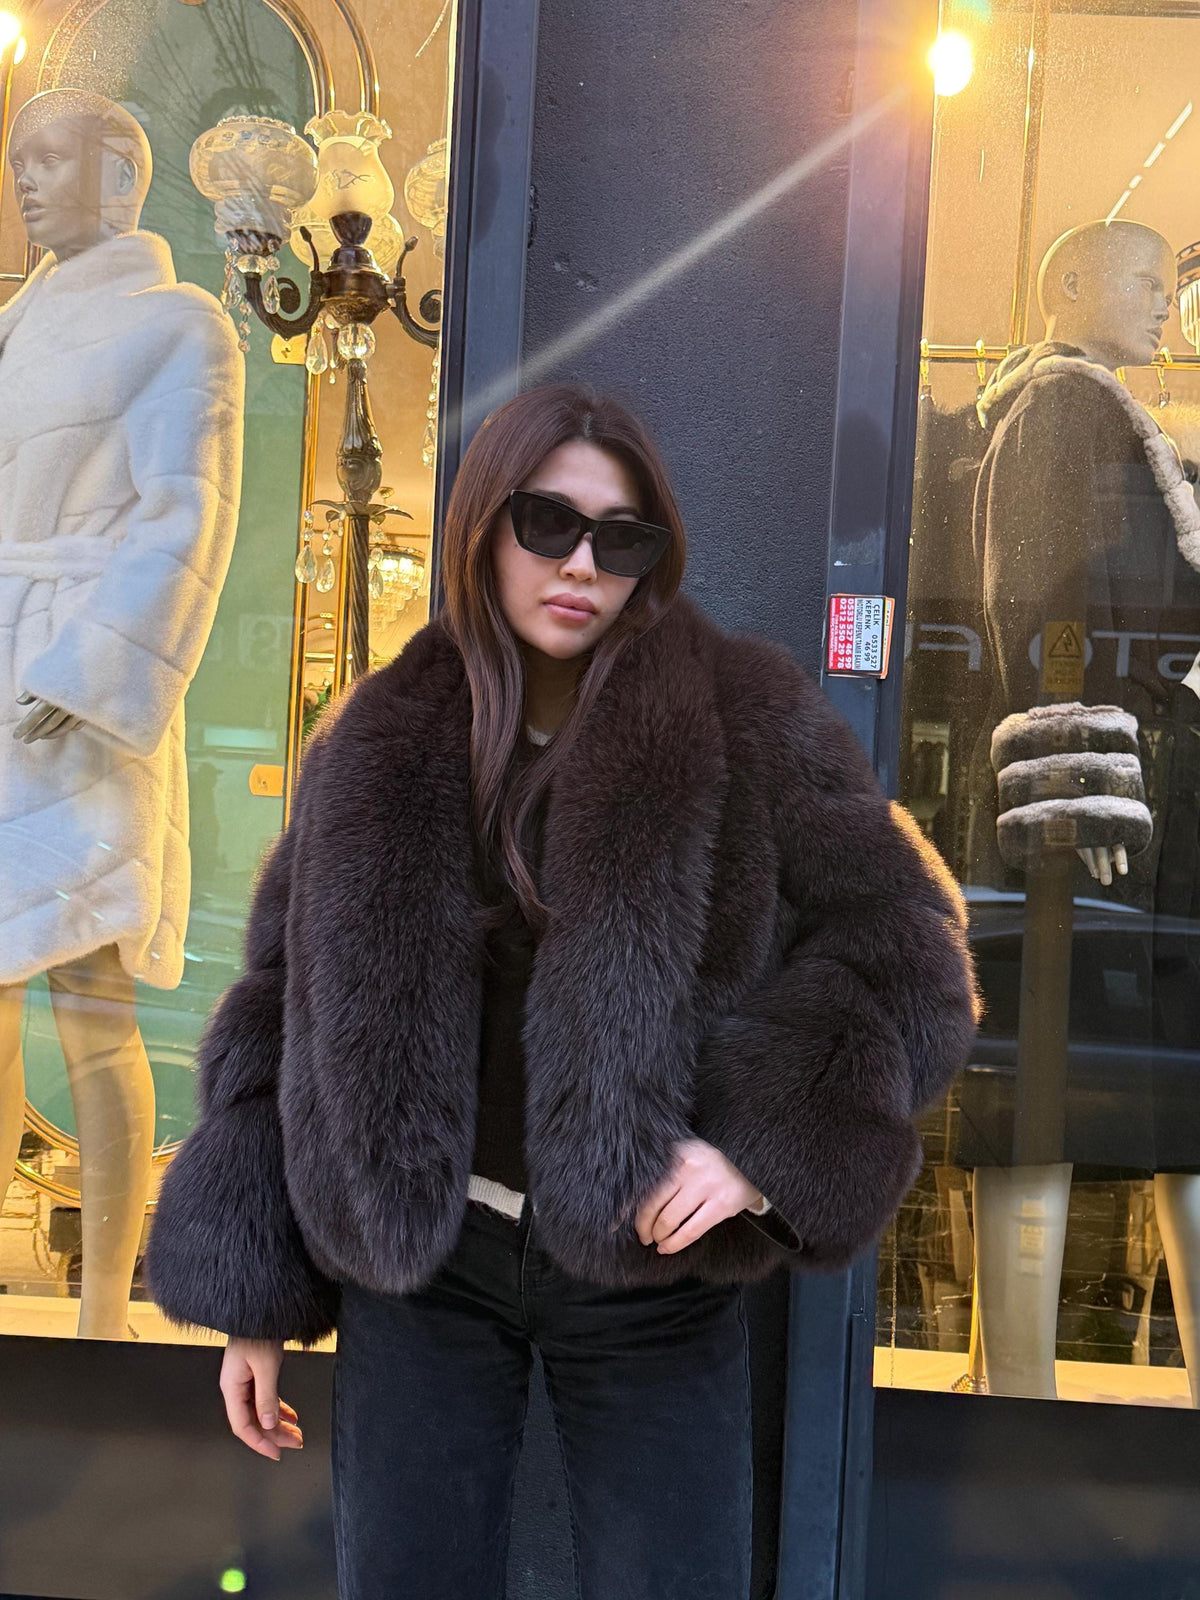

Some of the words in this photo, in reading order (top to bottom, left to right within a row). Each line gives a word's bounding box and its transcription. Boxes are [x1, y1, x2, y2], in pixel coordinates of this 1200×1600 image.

[873, 605, 881, 626] ÇELİK
[846, 643, 852, 655] 46
[865, 642, 871, 650] 46
[845, 657, 852, 669] 99
[864, 653, 870, 661] 99
